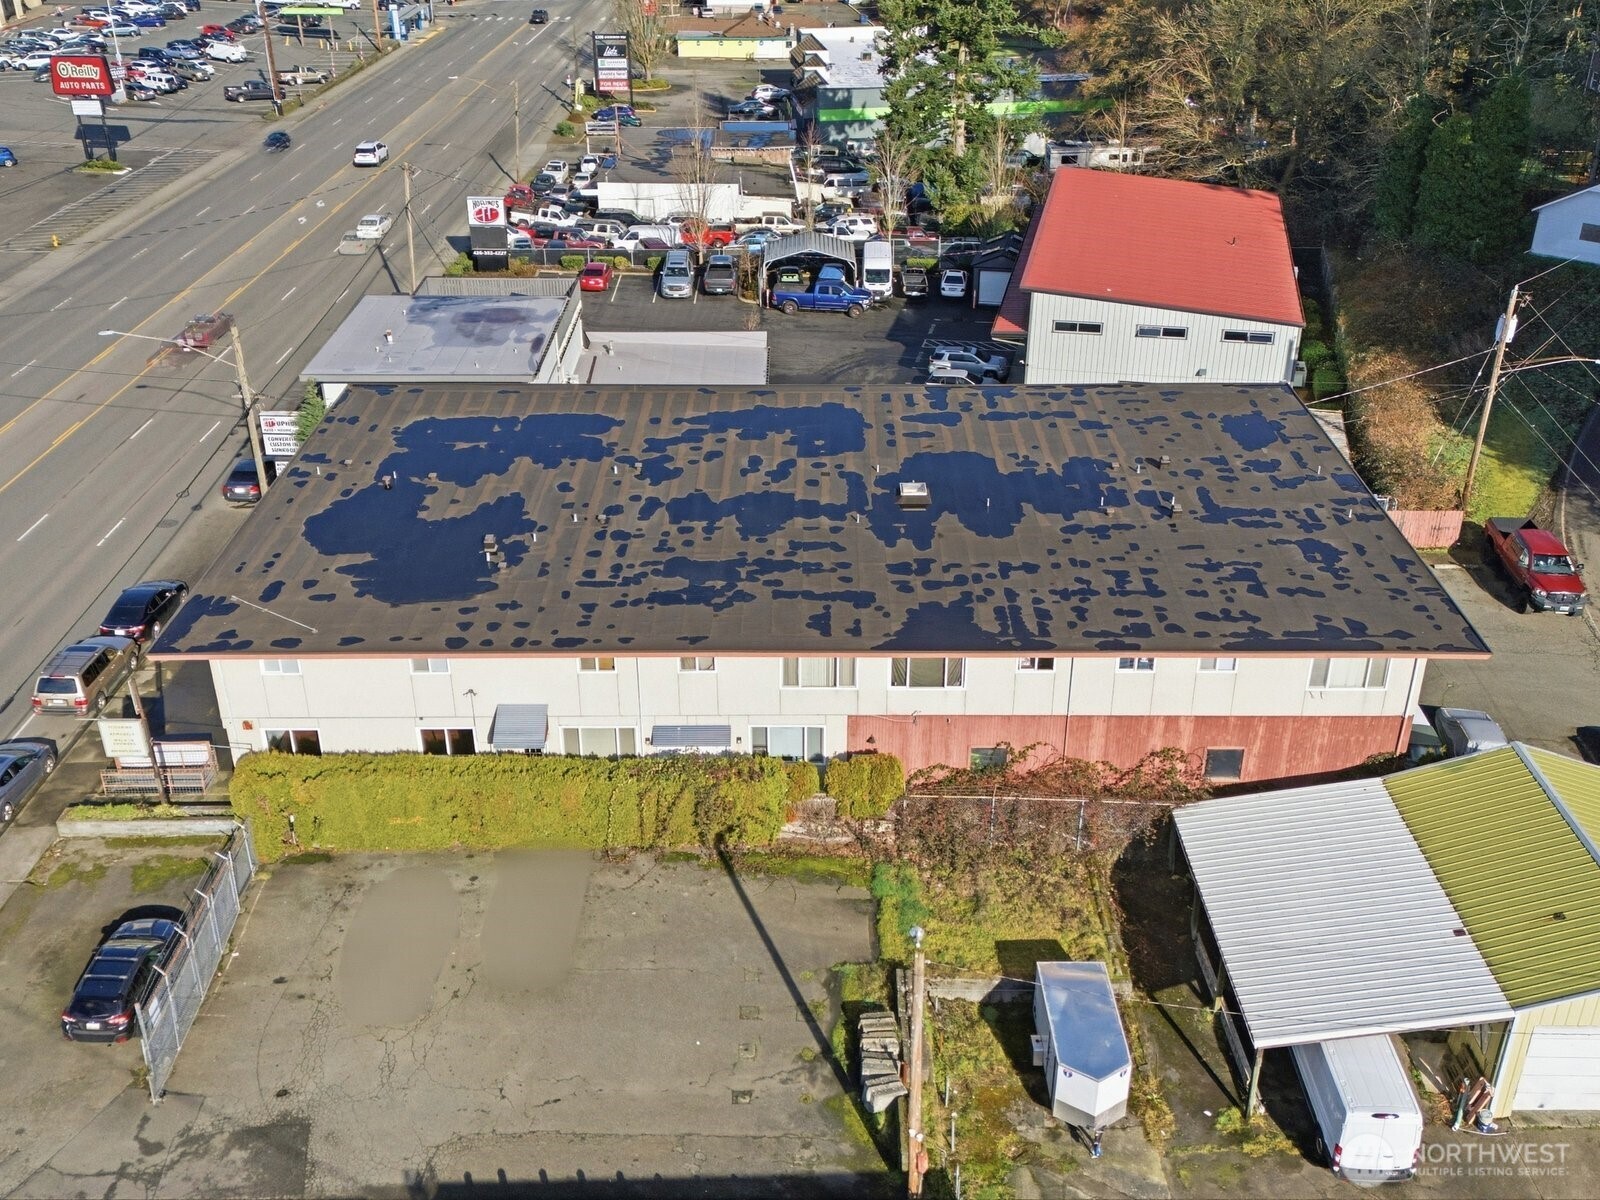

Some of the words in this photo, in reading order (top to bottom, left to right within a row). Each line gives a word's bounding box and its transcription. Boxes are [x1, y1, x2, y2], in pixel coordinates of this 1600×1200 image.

[57, 62, 99, 79] O'Reilly
[60, 81, 80, 89] AUTO
[81, 81, 105, 90] PARTS
